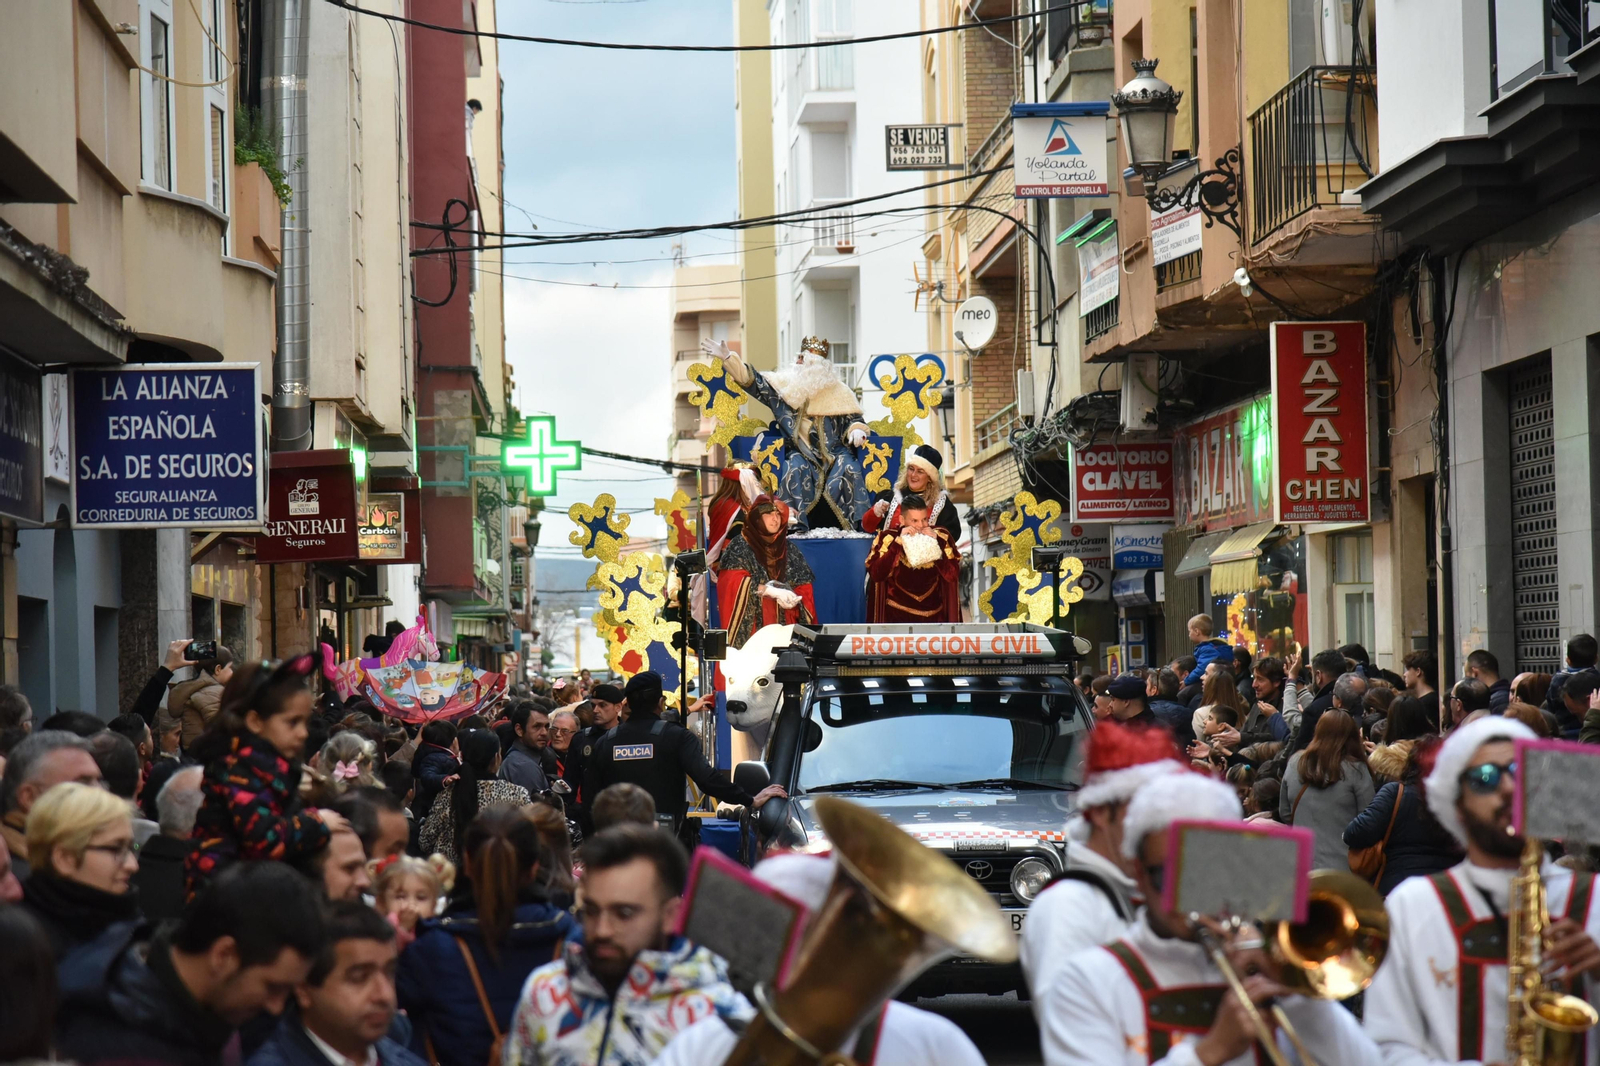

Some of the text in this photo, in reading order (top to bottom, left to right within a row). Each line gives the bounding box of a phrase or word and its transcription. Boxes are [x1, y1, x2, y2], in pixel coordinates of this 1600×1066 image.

[890, 128, 945, 146] SE VENDE
[892, 155, 942, 164] 692 027 732
[1025, 157, 1088, 172] Yolanda
[1020, 186, 1102, 195] CONTROL DE LEGIONELLA
[962, 309, 991, 320] meo
[101, 374, 229, 401] LA ALIANZA
[1301, 329, 1343, 473] BAZAR
[108, 410, 217, 440] ESPAÑOLA
[80, 452, 253, 480] S.A. DE SEGUROS
[1076, 450, 1170, 467] LOCUTORIO
[1190, 420, 1246, 518] BAZAR
[1082, 470, 1162, 491] CLAVEL
[115, 489, 218, 504] SEGURALIANZA
[1285, 478, 1361, 501] CHEN
[1080, 500, 1168, 509] ALIMENTOS LATINOS
[1293, 504, 1356, 512] REGALOS COMPLEMENTOS
[79, 506, 255, 522] CORREDURIA DE SEGUROS
[264, 518, 346, 537] GENERALI
[359, 527, 397, 535] Carbón
[285, 537, 326, 549] Seguros
[1123, 555, 1138, 564] 902
[1140, 555, 1149, 563] 51
[851, 635, 1042, 655] PROTECCION CIVIL
[615, 747, 651, 757] POLICIA
